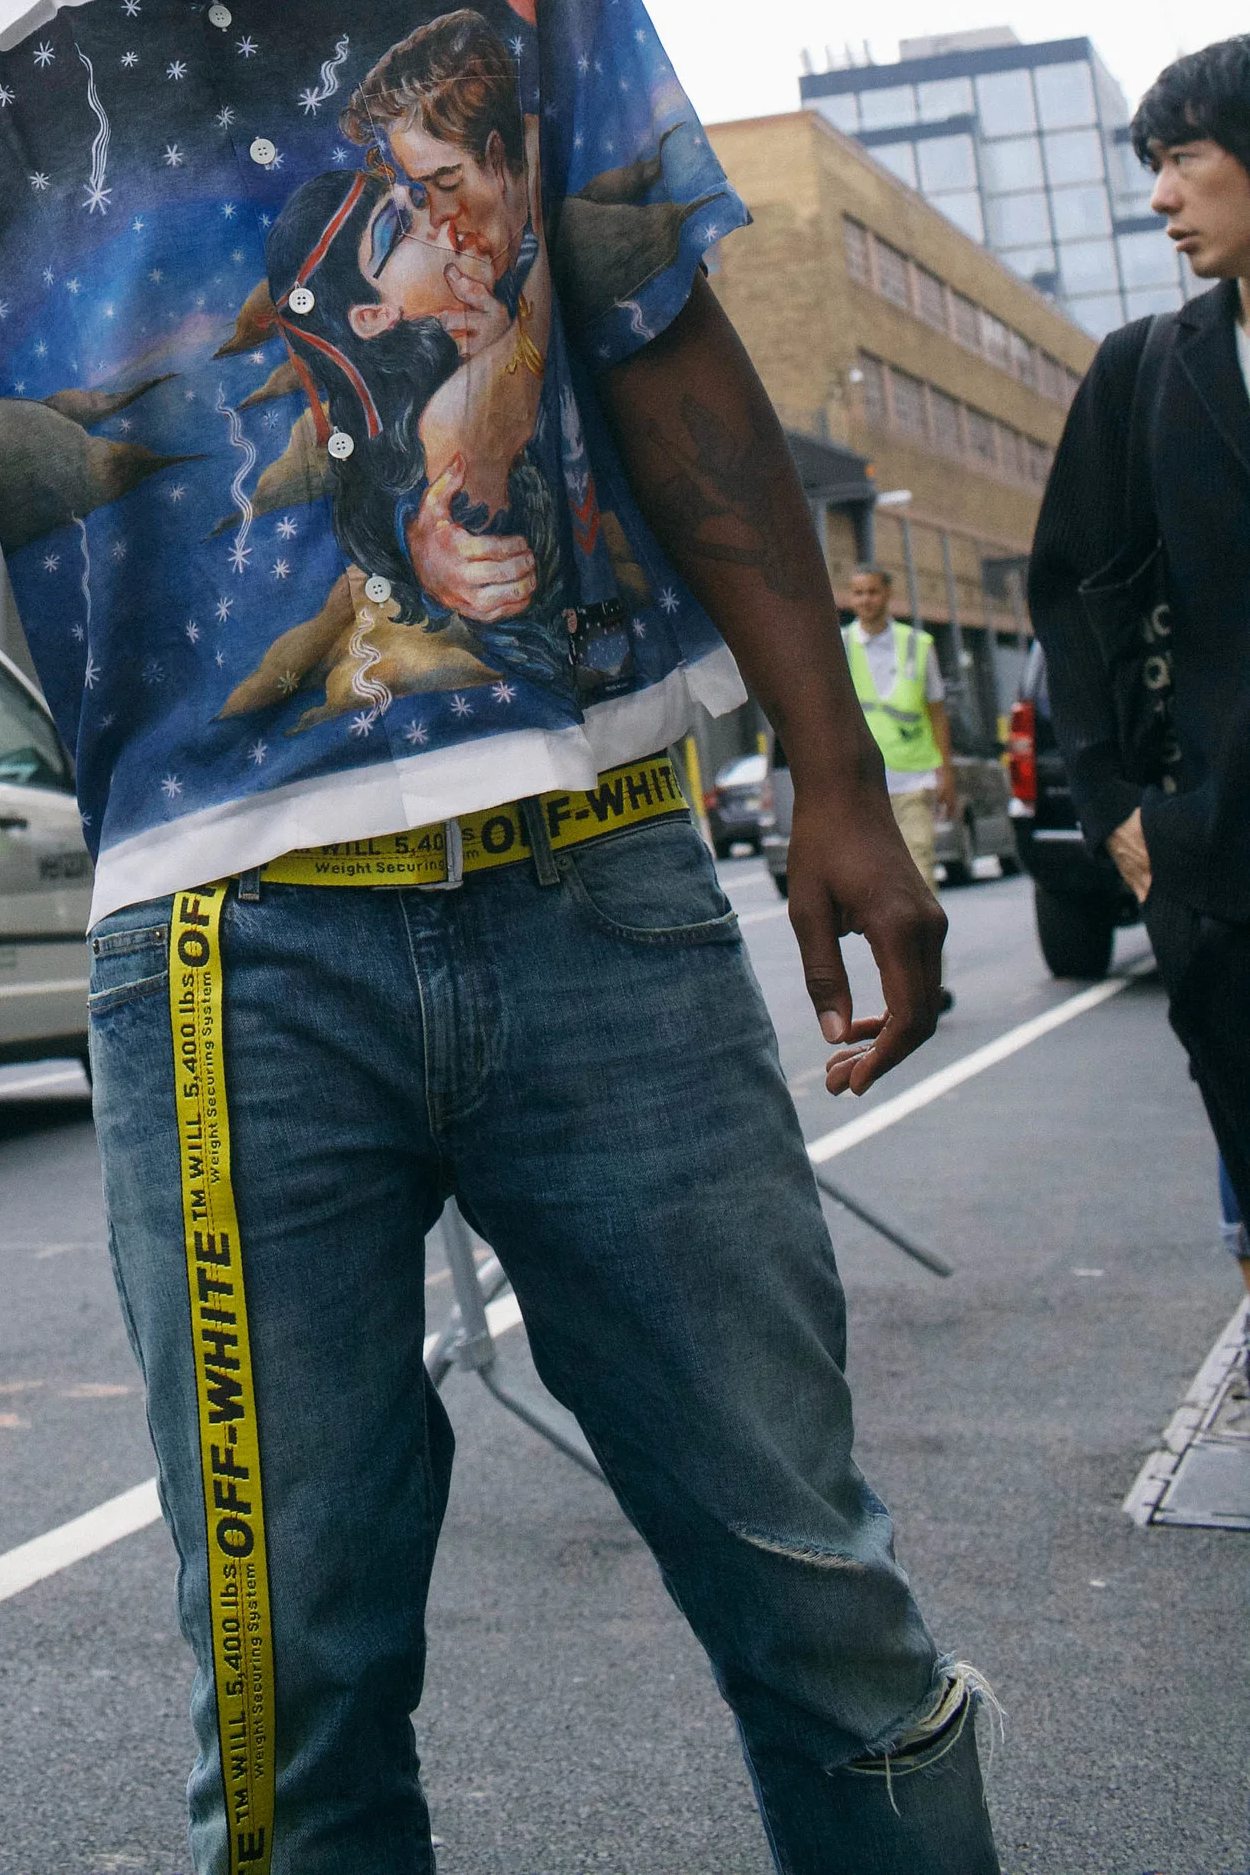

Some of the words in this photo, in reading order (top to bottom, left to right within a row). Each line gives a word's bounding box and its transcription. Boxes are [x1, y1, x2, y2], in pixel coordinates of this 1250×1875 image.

[394, 833, 445, 856] 5,40
[481, 766, 682, 855] OF-WHIT
[315, 857, 371, 875] Weight
[179, 973, 196, 1014] lbs
[201, 971, 213, 1036] System
[181, 1023, 203, 1098] 5,400
[203, 1041, 218, 1117] Securing
[186, 1113, 204, 1179] WILL
[209, 1125, 222, 1184] Weight
[191, 1189, 207, 1223] TM
[194, 1230, 254, 1558] OFF-WHITE
[220, 1563, 238, 1608] lbs
[246, 1563, 261, 1632] System
[222, 1618, 245, 1697] 5,400
[250, 1637, 264, 1714] Securing
[228, 1712, 246, 1781] WILL
[253, 1720, 265, 1780] Weight
